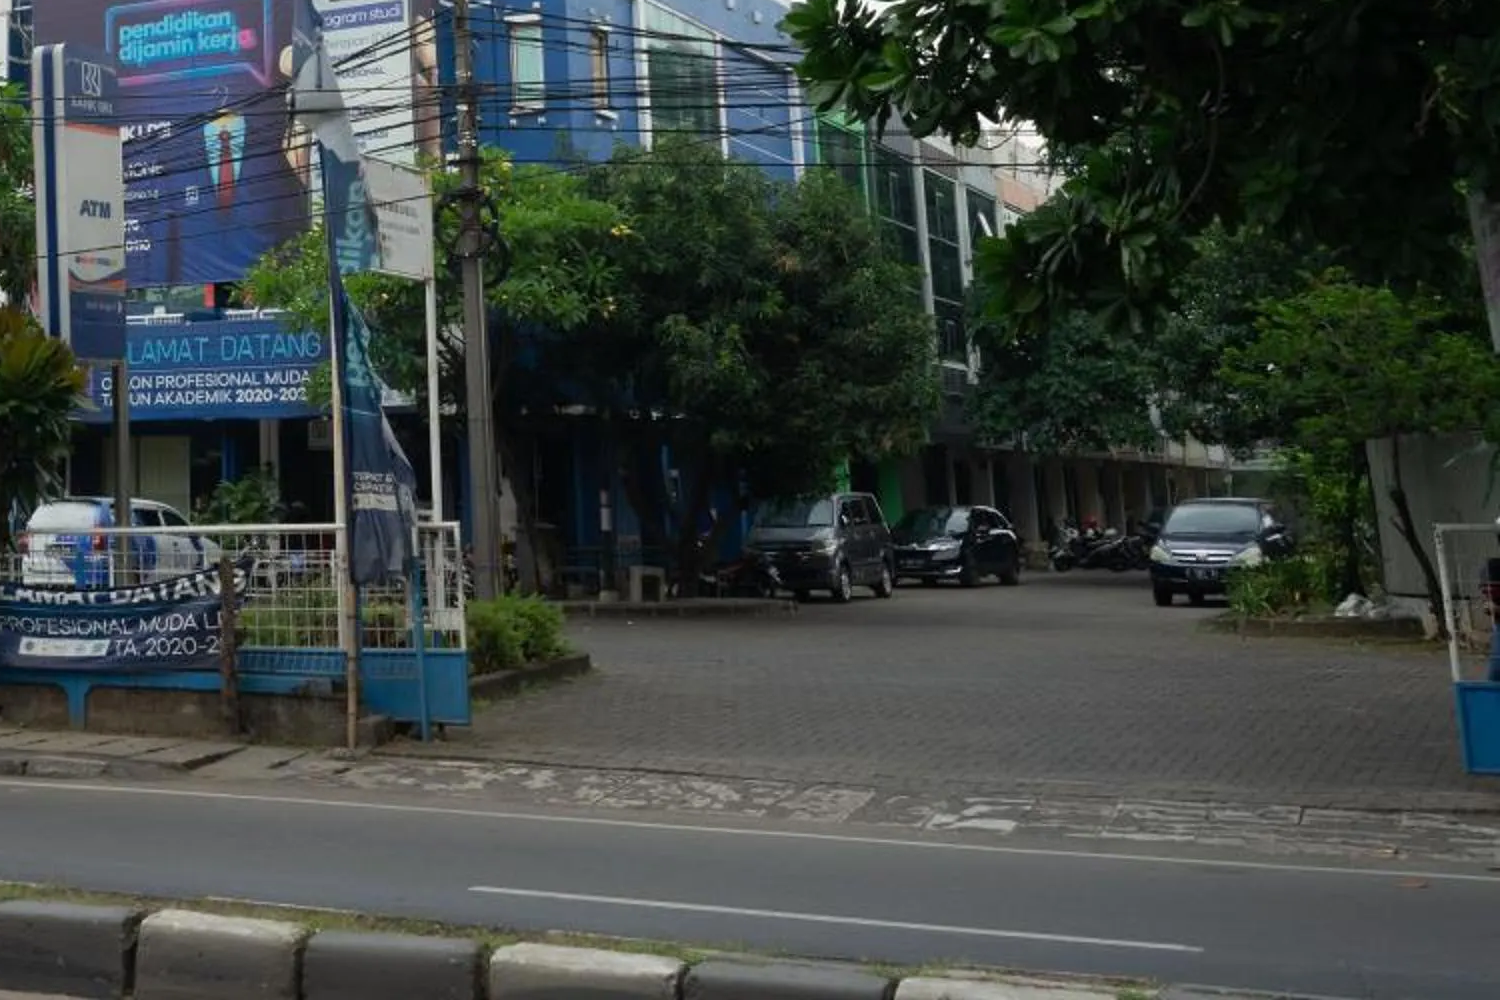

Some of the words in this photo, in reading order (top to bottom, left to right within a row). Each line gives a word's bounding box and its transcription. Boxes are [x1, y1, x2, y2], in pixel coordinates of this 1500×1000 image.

[119, 9, 232, 43] pendidikan
[323, 11, 369, 31] ogram
[370, 3, 401, 21] studi
[119, 35, 195, 67] dijamin
[198, 28, 258, 56] kerja
[79, 199, 111, 219] ATM
[127, 337, 208, 365] LAMAT
[221, 332, 322, 361] DATANG
[101, 374, 152, 391] CON
[155, 371, 261, 389] PROFESIONAL
[264, 368, 311, 386] MUDA
[101, 390, 151, 406] TUN
[153, 390, 233, 405] AKADEMIK
[0, 614, 133, 636] PROFESIONAL
[138, 613, 198, 632] MUDA
